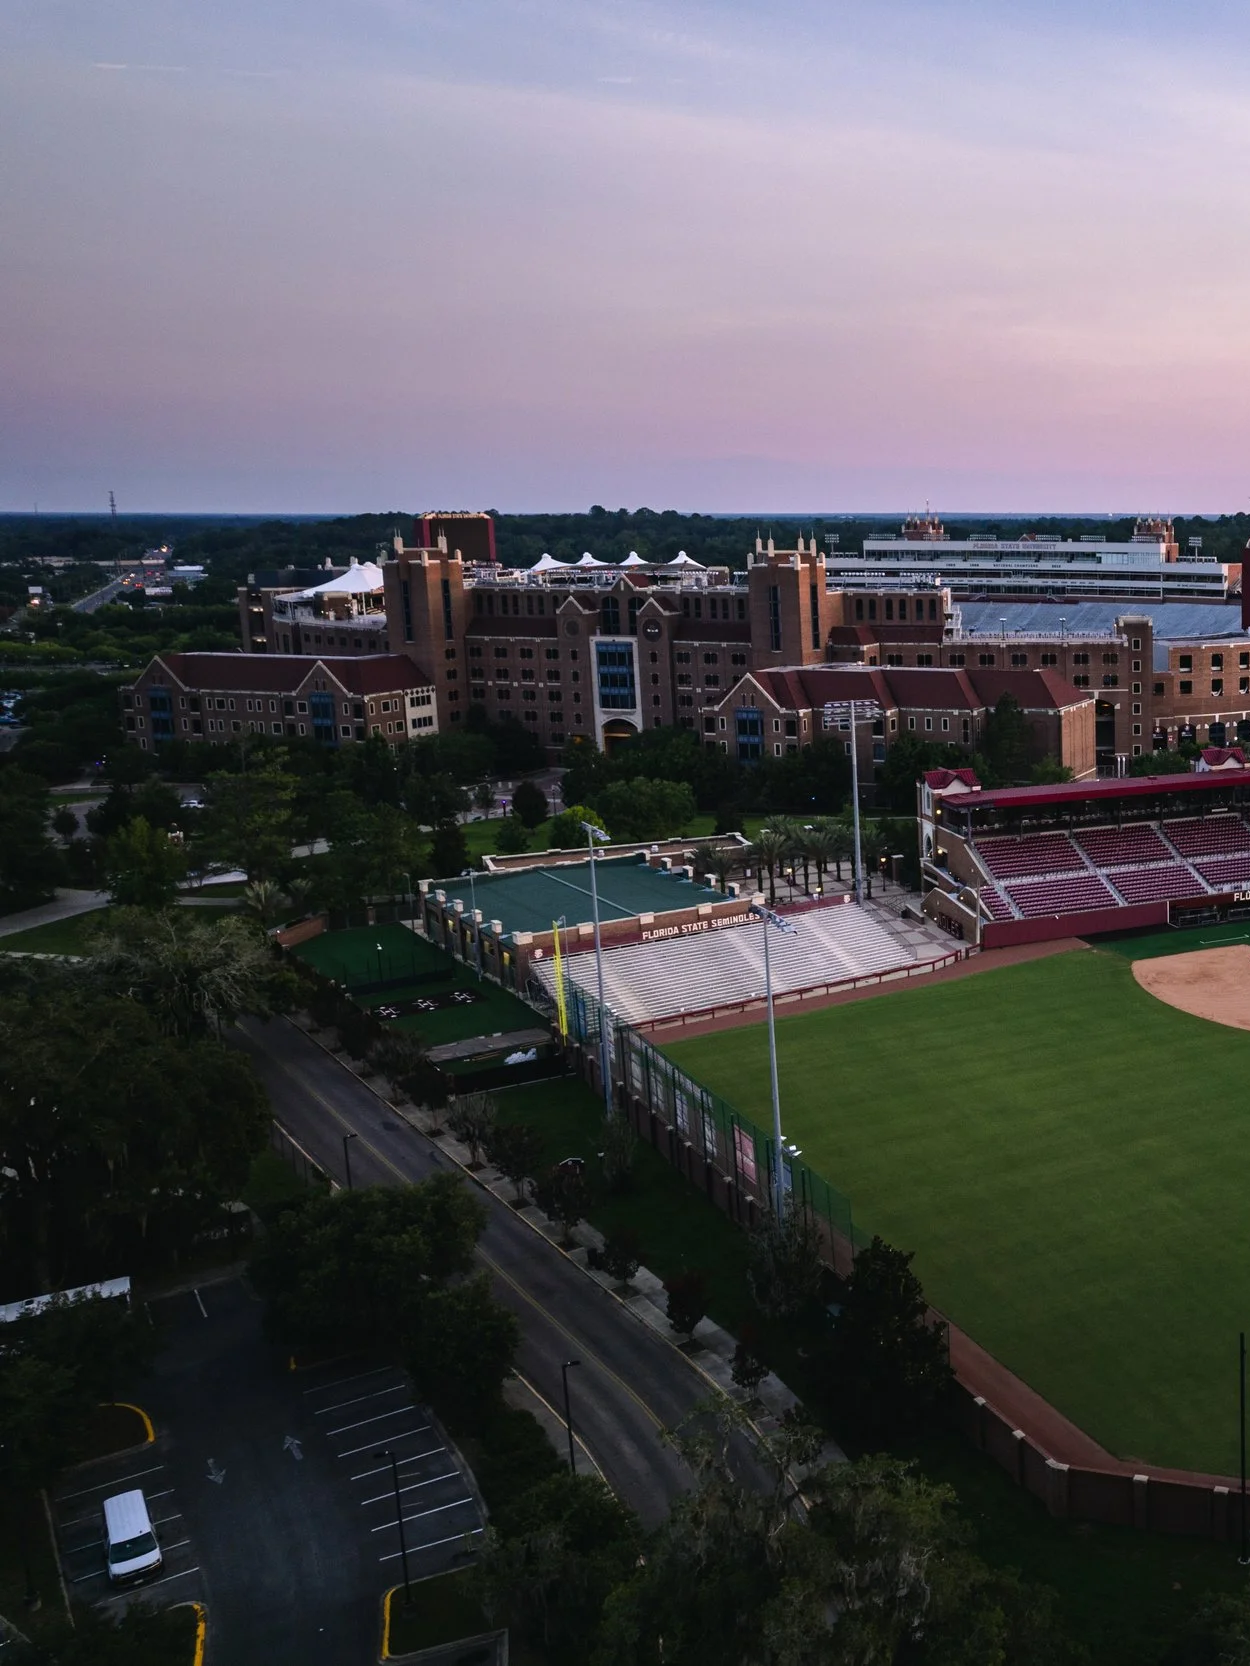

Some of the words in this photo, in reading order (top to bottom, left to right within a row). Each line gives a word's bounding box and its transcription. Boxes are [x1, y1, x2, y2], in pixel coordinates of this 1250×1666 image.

[642, 926, 679, 940] FLORIDA
[681, 921, 709, 934] STATE
[711, 912, 760, 928] SEMINOLES
